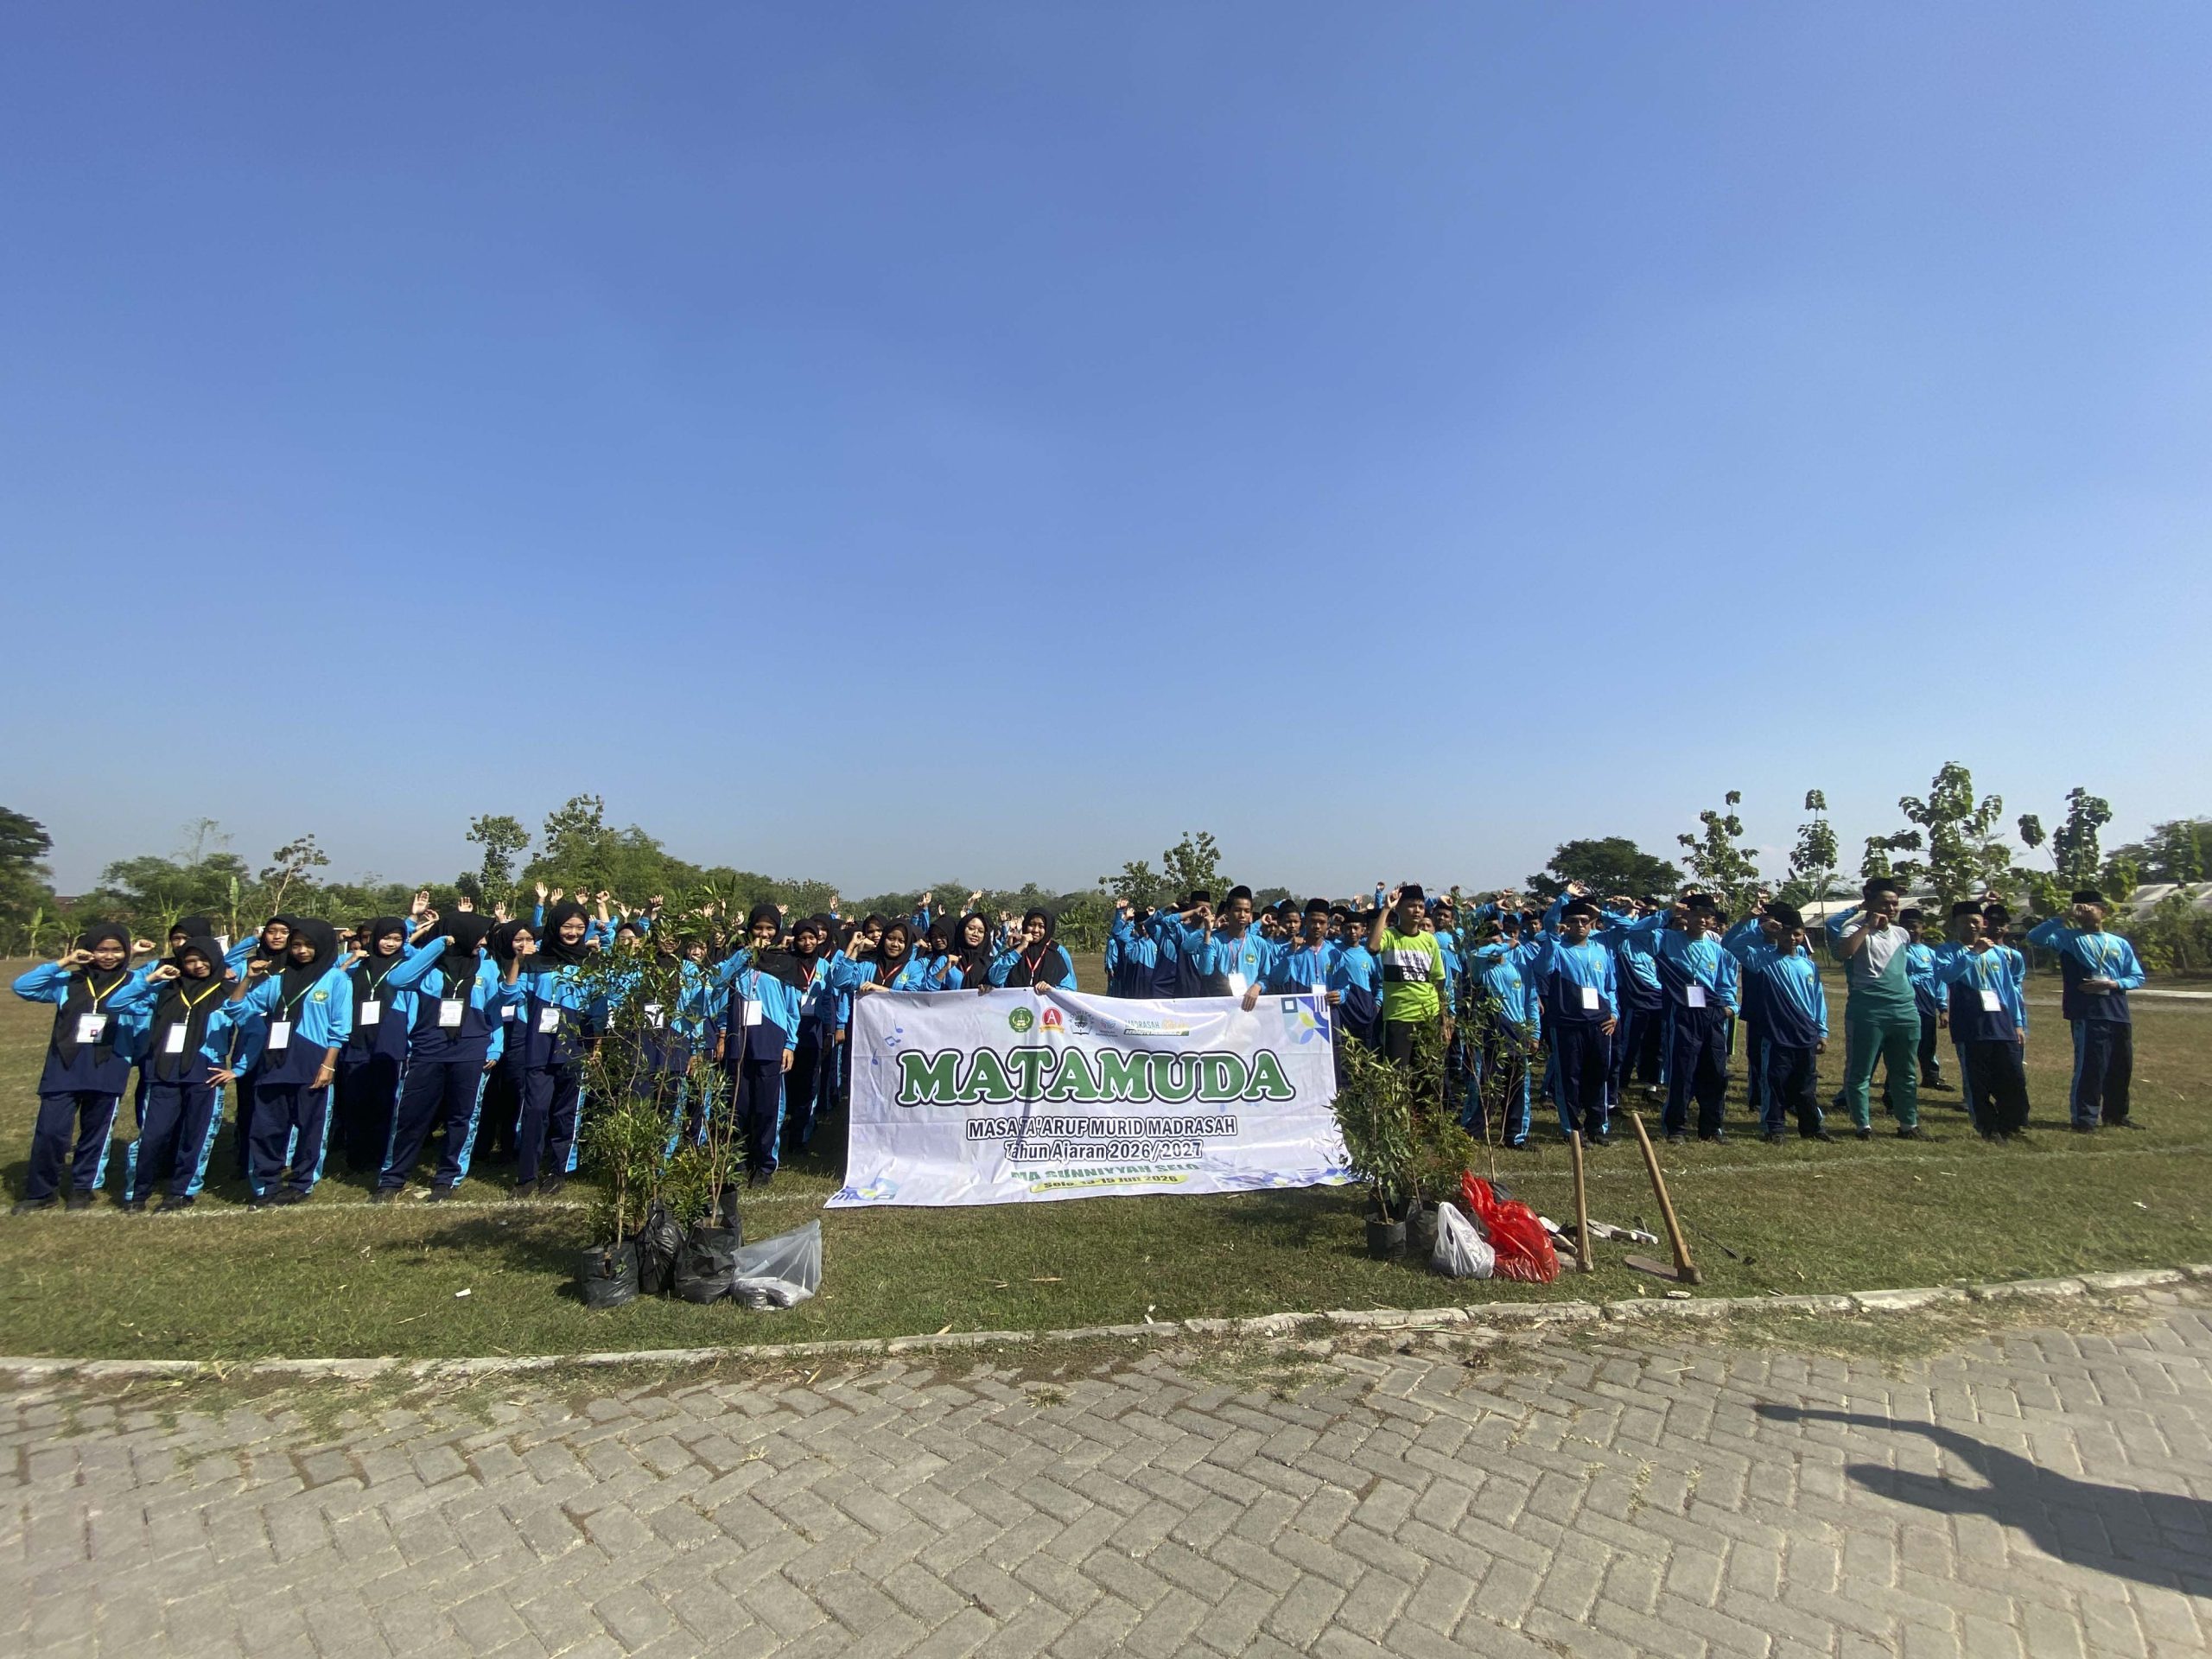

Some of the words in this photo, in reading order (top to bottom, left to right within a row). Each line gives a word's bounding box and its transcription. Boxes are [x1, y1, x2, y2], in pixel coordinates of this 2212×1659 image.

[895, 1046, 1296, 1107] MATAMUDA
[968, 1119, 1017, 1139] MASA
[1090, 1118, 1144, 1136] MURID
[1147, 1116, 1236, 1136] MADRASAH
[1006, 1141, 1048, 1160] Tahun
[1052, 1141, 1106, 1163] Ajaran
[1109, 1141, 1202, 1161] 2026/2027
[1045, 1166, 1152, 1179] SUNNIYYAH
[1154, 1163, 1201, 1173] SELO
